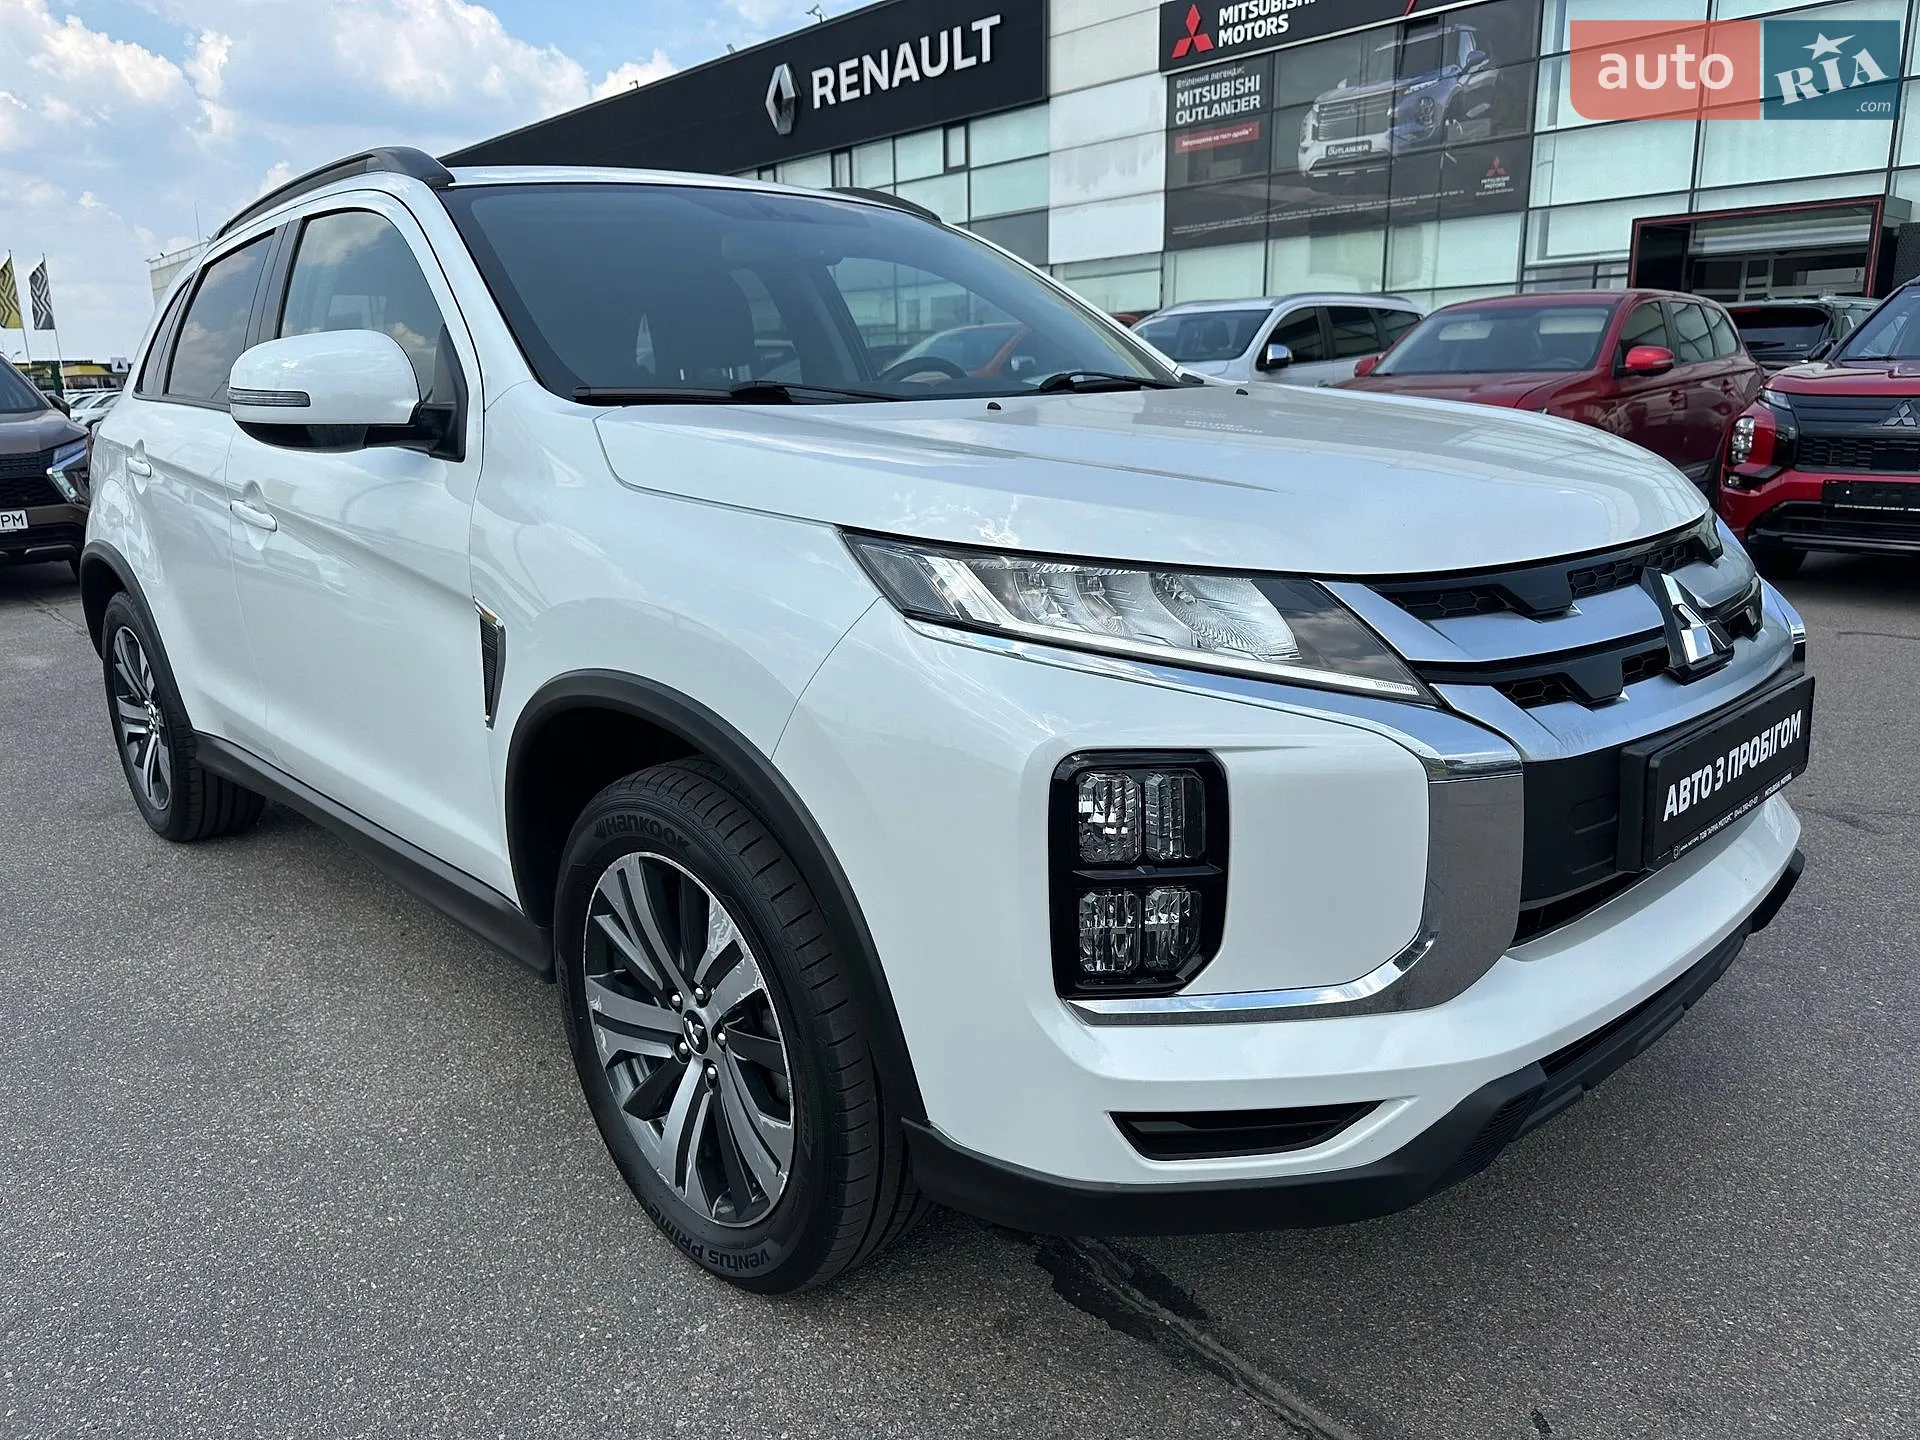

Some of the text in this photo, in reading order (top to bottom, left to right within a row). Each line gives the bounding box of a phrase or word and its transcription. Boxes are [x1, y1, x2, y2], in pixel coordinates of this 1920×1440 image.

[1219, 0, 1316, 26] MITSUBIS
[1218, 14, 1289, 48] MOTORS
[811, 14, 1001, 110] RENAULT
[1176, 74, 1260, 108] MITSUBISHI
[1175, 95, 1260, 125] OUTLANDER
[1662, 764, 1713, 823] АВТО
[1727, 710, 1802, 783] ПРОБІГОМ
